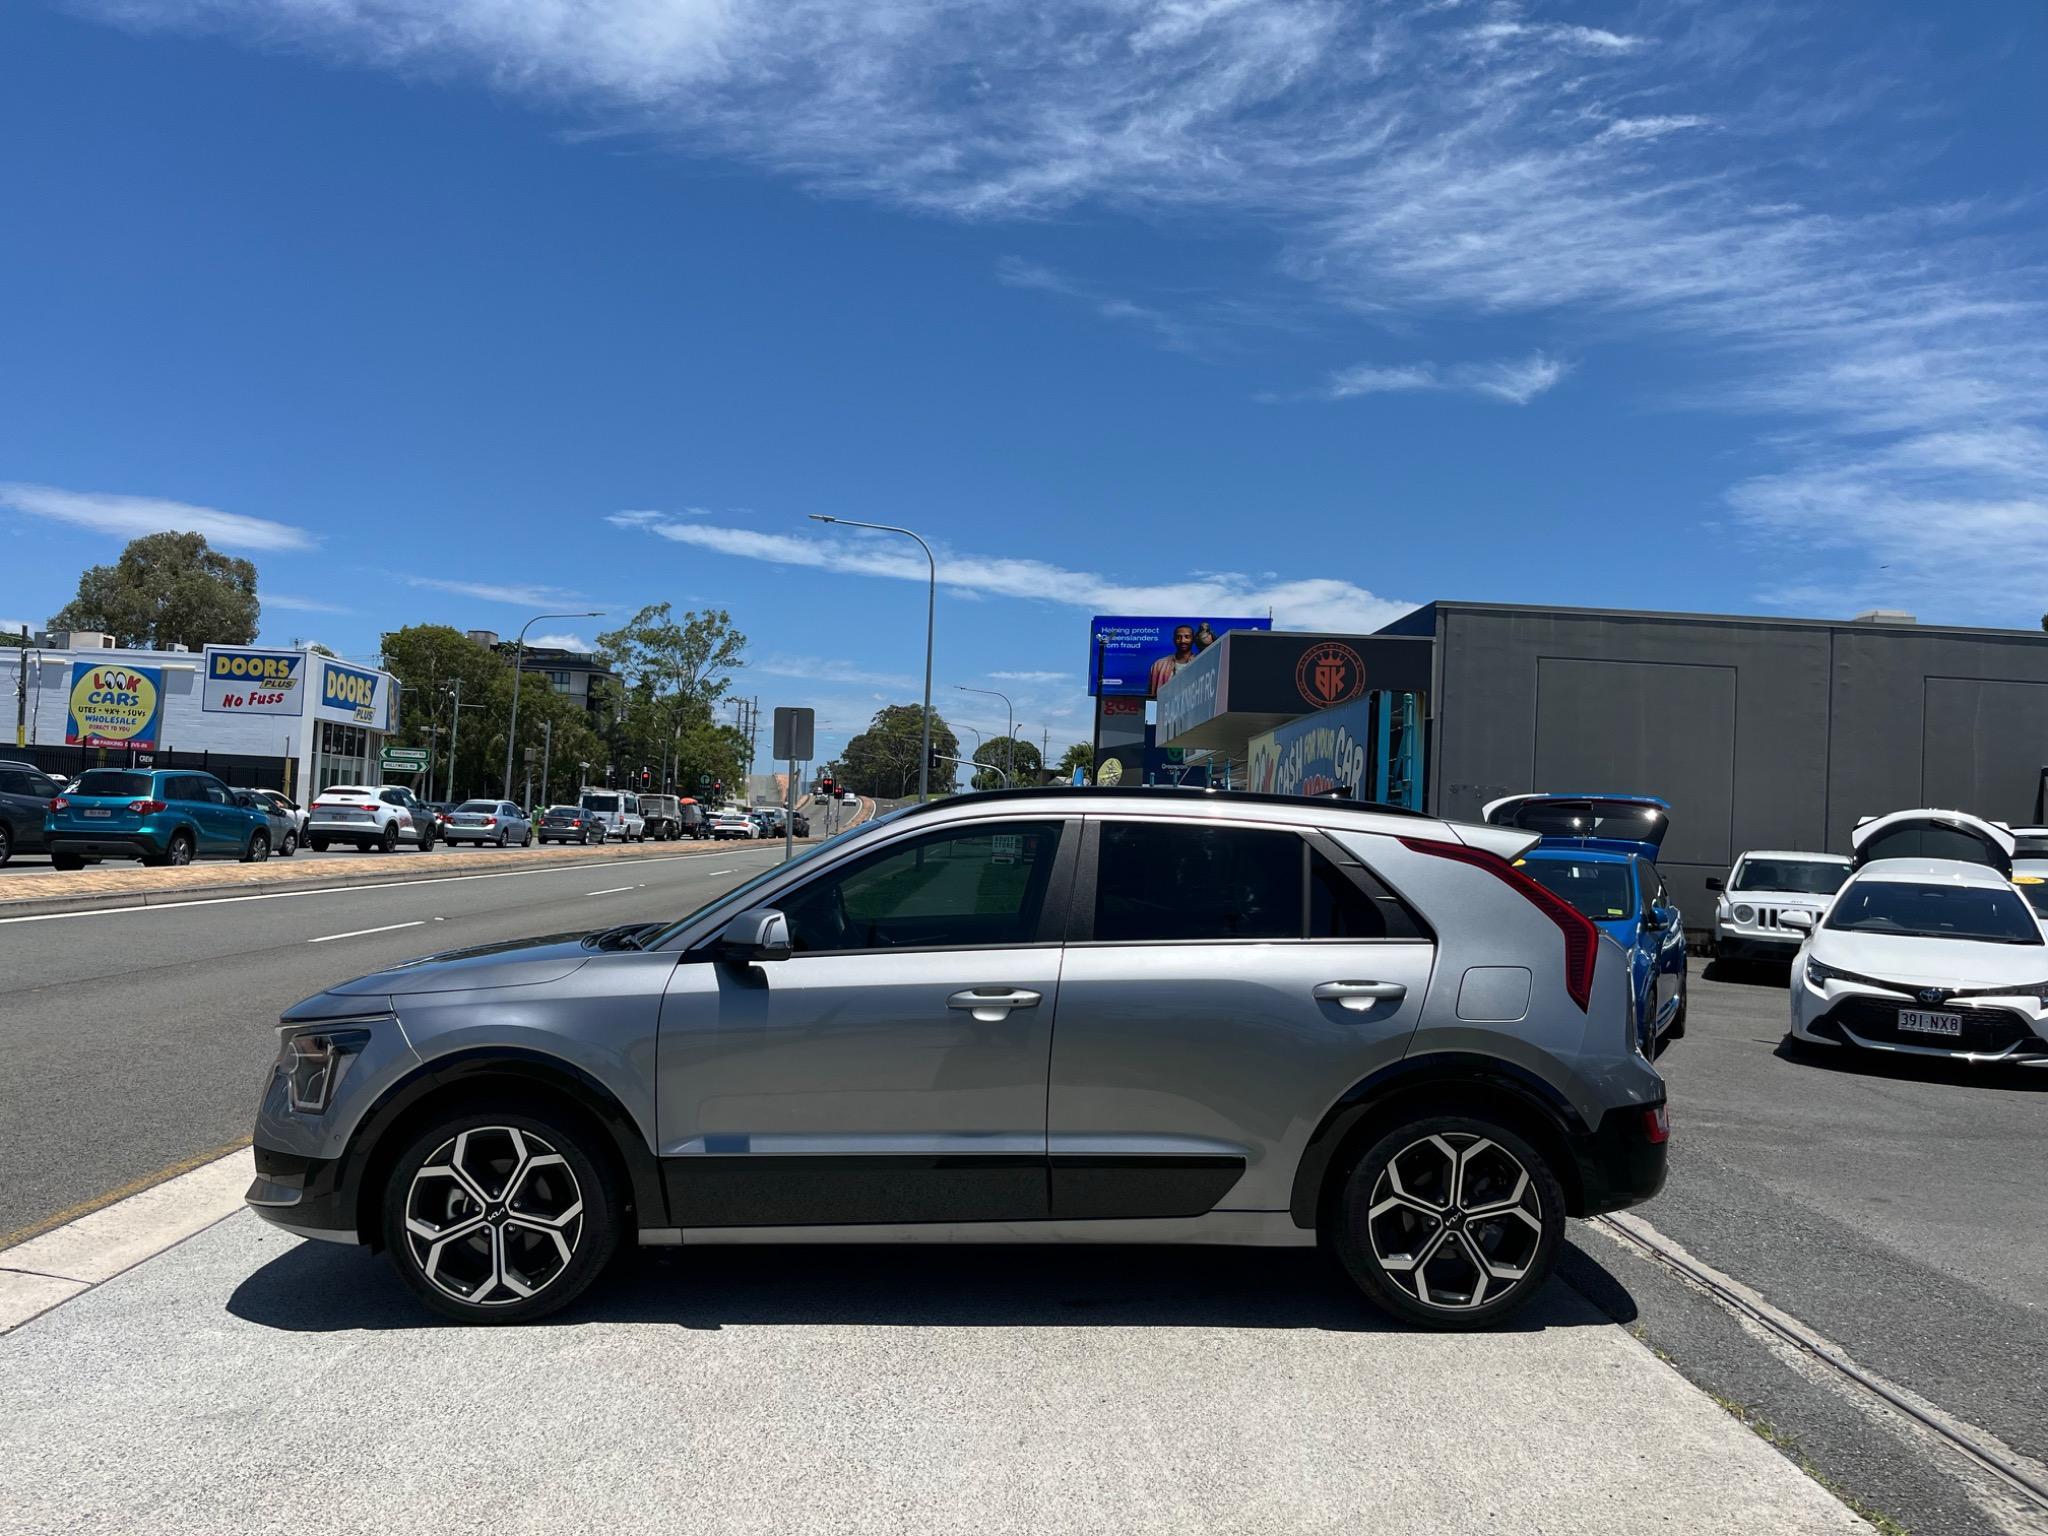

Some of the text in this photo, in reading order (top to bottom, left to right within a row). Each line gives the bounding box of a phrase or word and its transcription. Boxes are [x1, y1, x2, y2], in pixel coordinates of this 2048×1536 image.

[1131, 627, 1160, 635] protect
[216, 656, 290, 679] DOORS
[93, 671, 141, 692] LOOK
[264, 680, 293, 688] PLUS
[326, 670, 372, 706] DOORS
[1205, 667, 1216, 701] RC
[88, 691, 139, 706] CARS
[222, 692, 284, 708] No Fuss
[84, 714, 137, 725] WHOLESALE
[355, 708, 374, 721] PLUS
[1277, 735, 1303, 794] CASH
[1334, 725, 1364, 800] CAR
